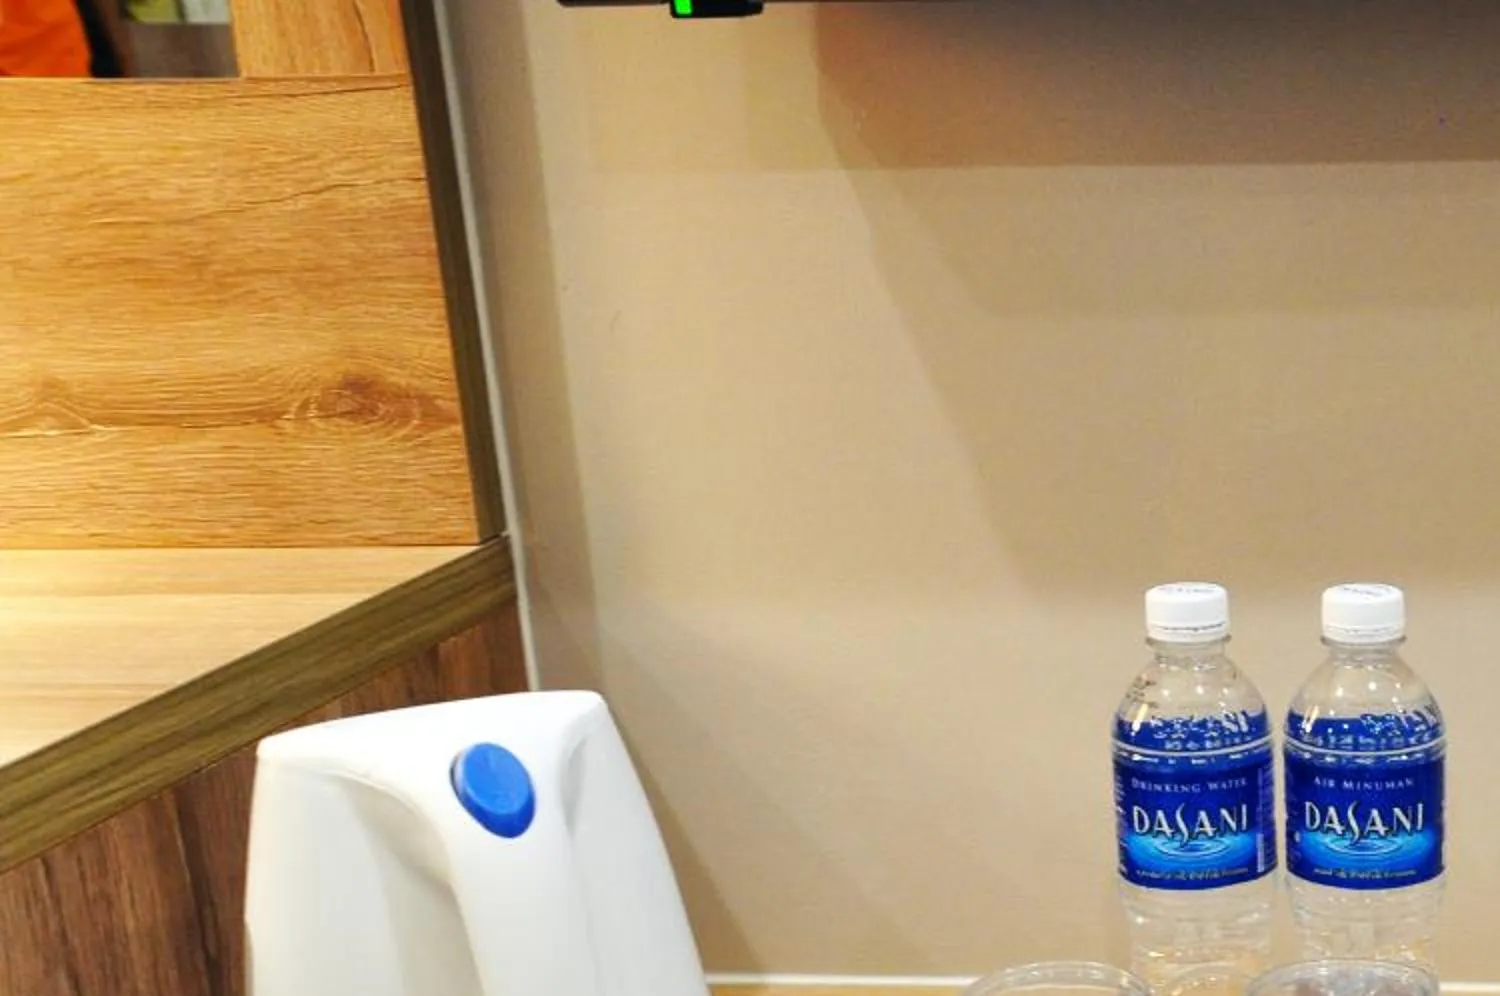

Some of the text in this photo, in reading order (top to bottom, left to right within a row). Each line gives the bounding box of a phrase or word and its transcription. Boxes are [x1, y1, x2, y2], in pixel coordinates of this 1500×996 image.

[1131, 776, 1201, 793] DRINKING
[1314, 775, 1415, 791] AIR MINUMAN
[1132, 802, 1248, 847] DASANI
[1304, 800, 1424, 845] DASANI
